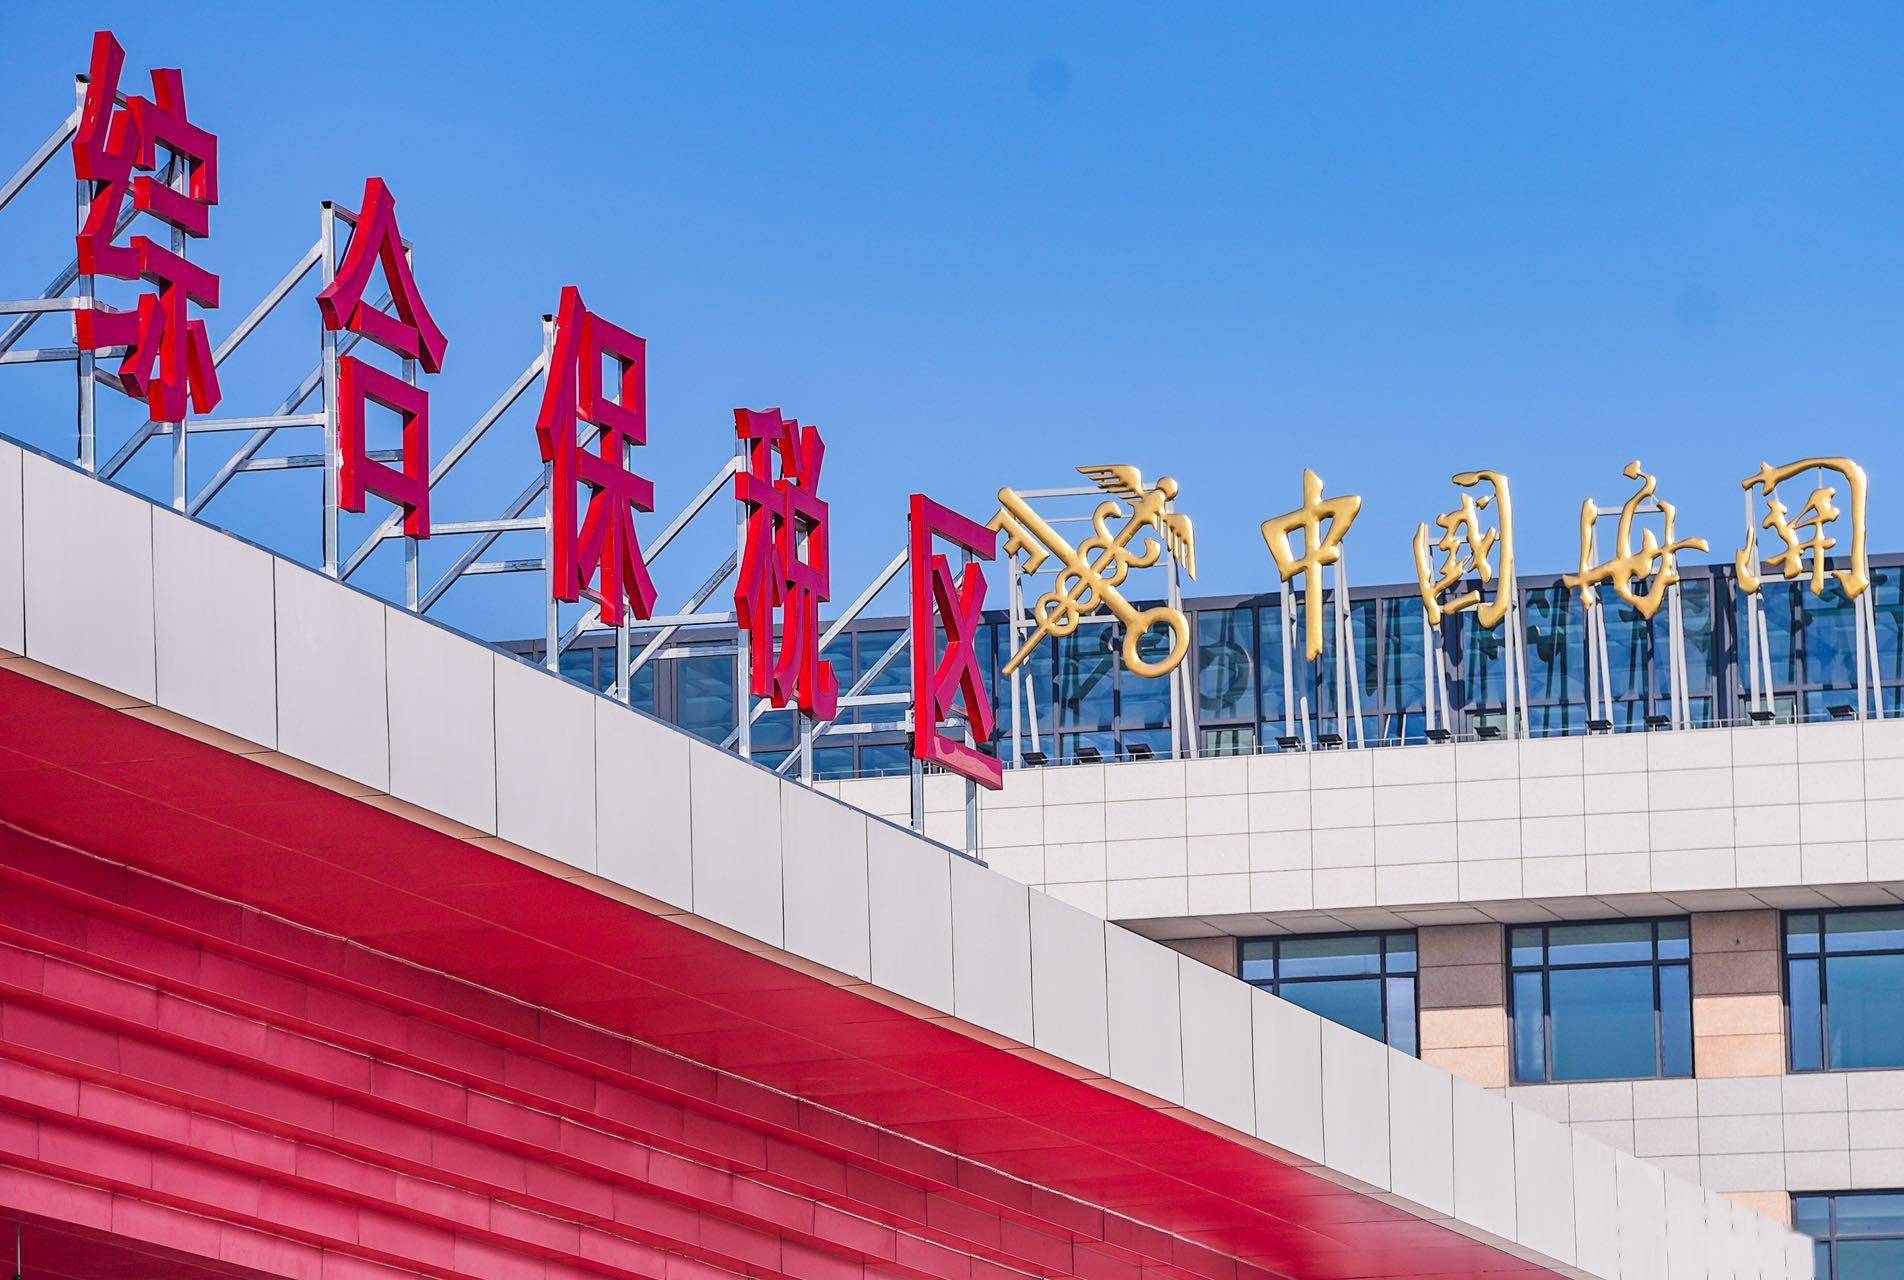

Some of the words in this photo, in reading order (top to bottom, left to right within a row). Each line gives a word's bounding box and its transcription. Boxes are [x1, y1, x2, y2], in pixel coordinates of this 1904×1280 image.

[73, 30, 1003, 790] 综合保税区
